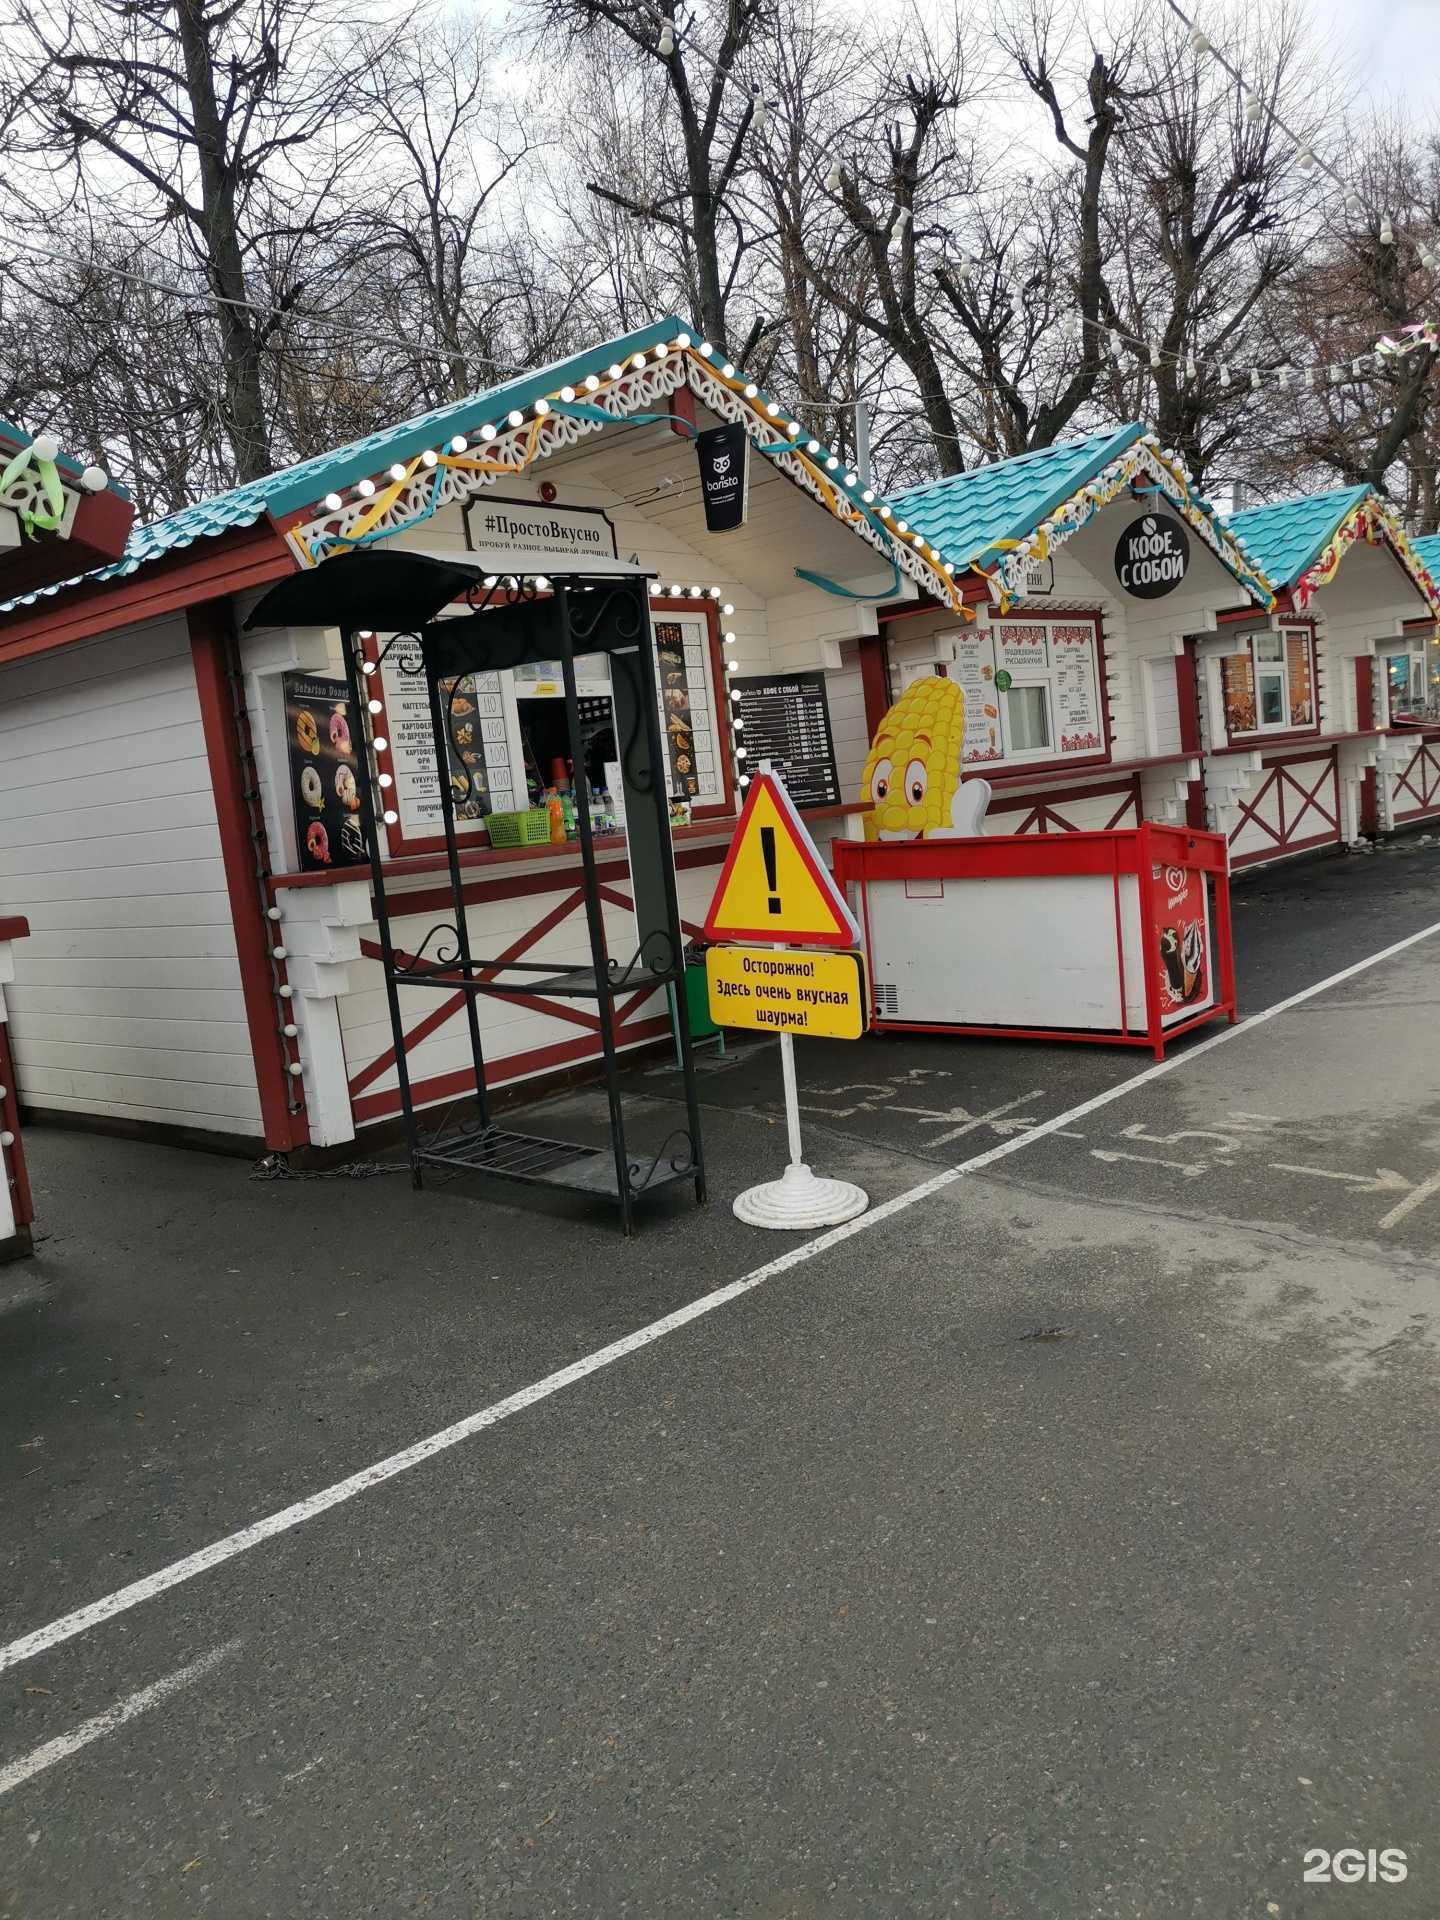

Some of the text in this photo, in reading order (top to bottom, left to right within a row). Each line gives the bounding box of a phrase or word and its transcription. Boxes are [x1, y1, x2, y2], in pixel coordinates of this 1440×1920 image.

[706, 475, 739, 492] barista
[485, 514, 600, 545] #ПростоВкусно
[478, 540, 511, 549] ПРОБУЙ
[1128, 531, 1173, 561] КОФЕ
[1120, 549, 1184, 587] С СОБОЙ
[743, 957, 814, 977] Осторожно!
[716, 979, 849, 1005] Здесь очень вкусная
[756, 1009, 808, 1027] шаурма!
